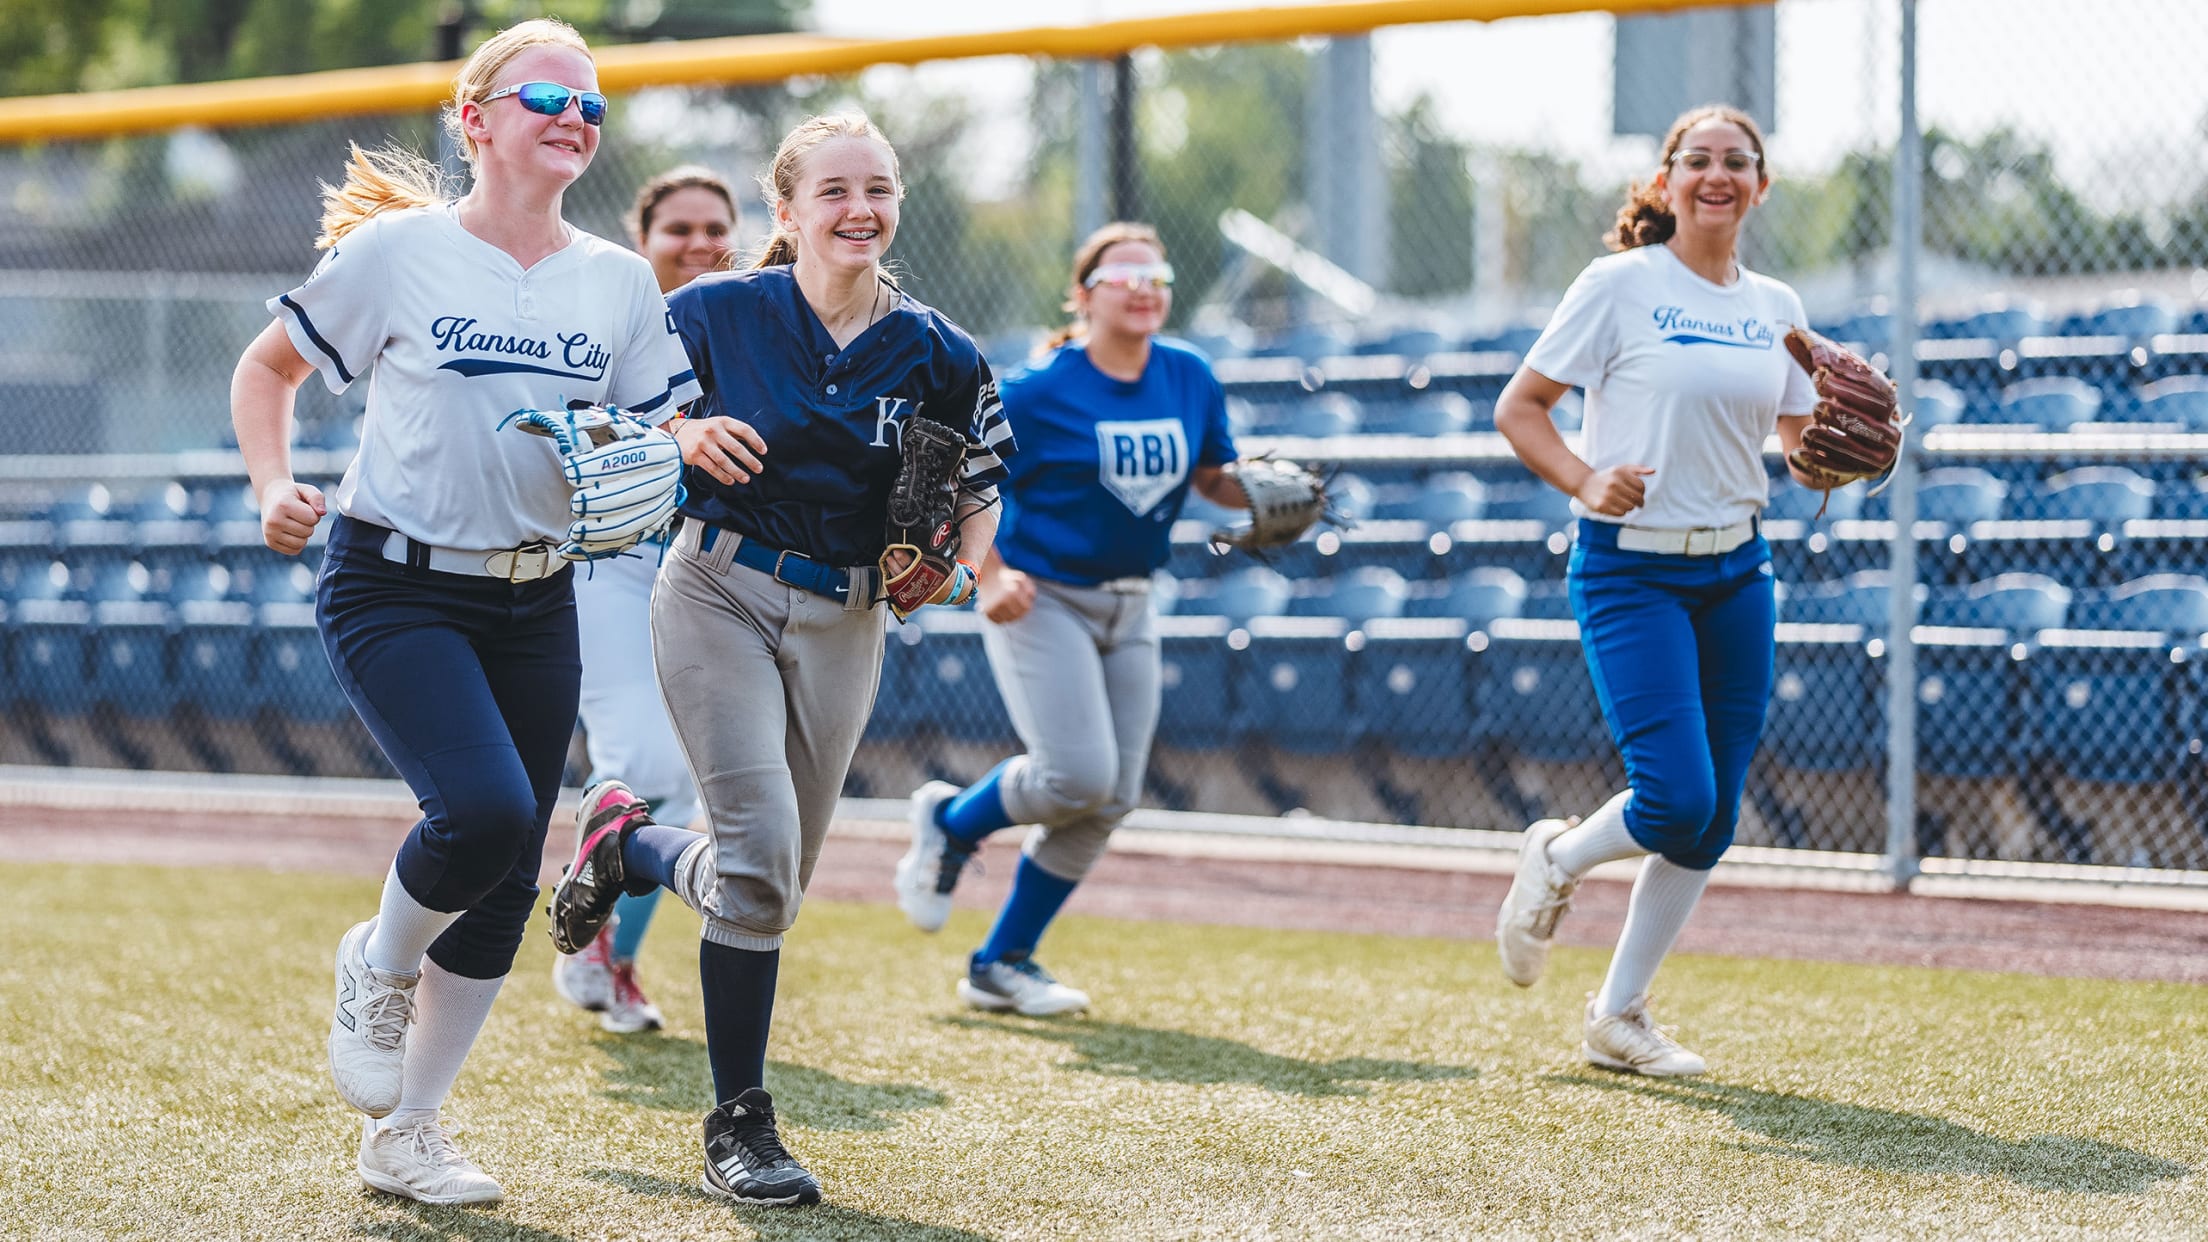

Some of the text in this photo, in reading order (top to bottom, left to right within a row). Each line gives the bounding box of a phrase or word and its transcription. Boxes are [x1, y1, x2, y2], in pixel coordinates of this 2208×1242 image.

[431, 316, 612, 374] Kansas City
[1653, 305, 1774, 346] Kansas City
[869, 396, 910, 456] K
[601, 451, 646, 470] A2000
[1113, 433, 1177, 477] RBI
